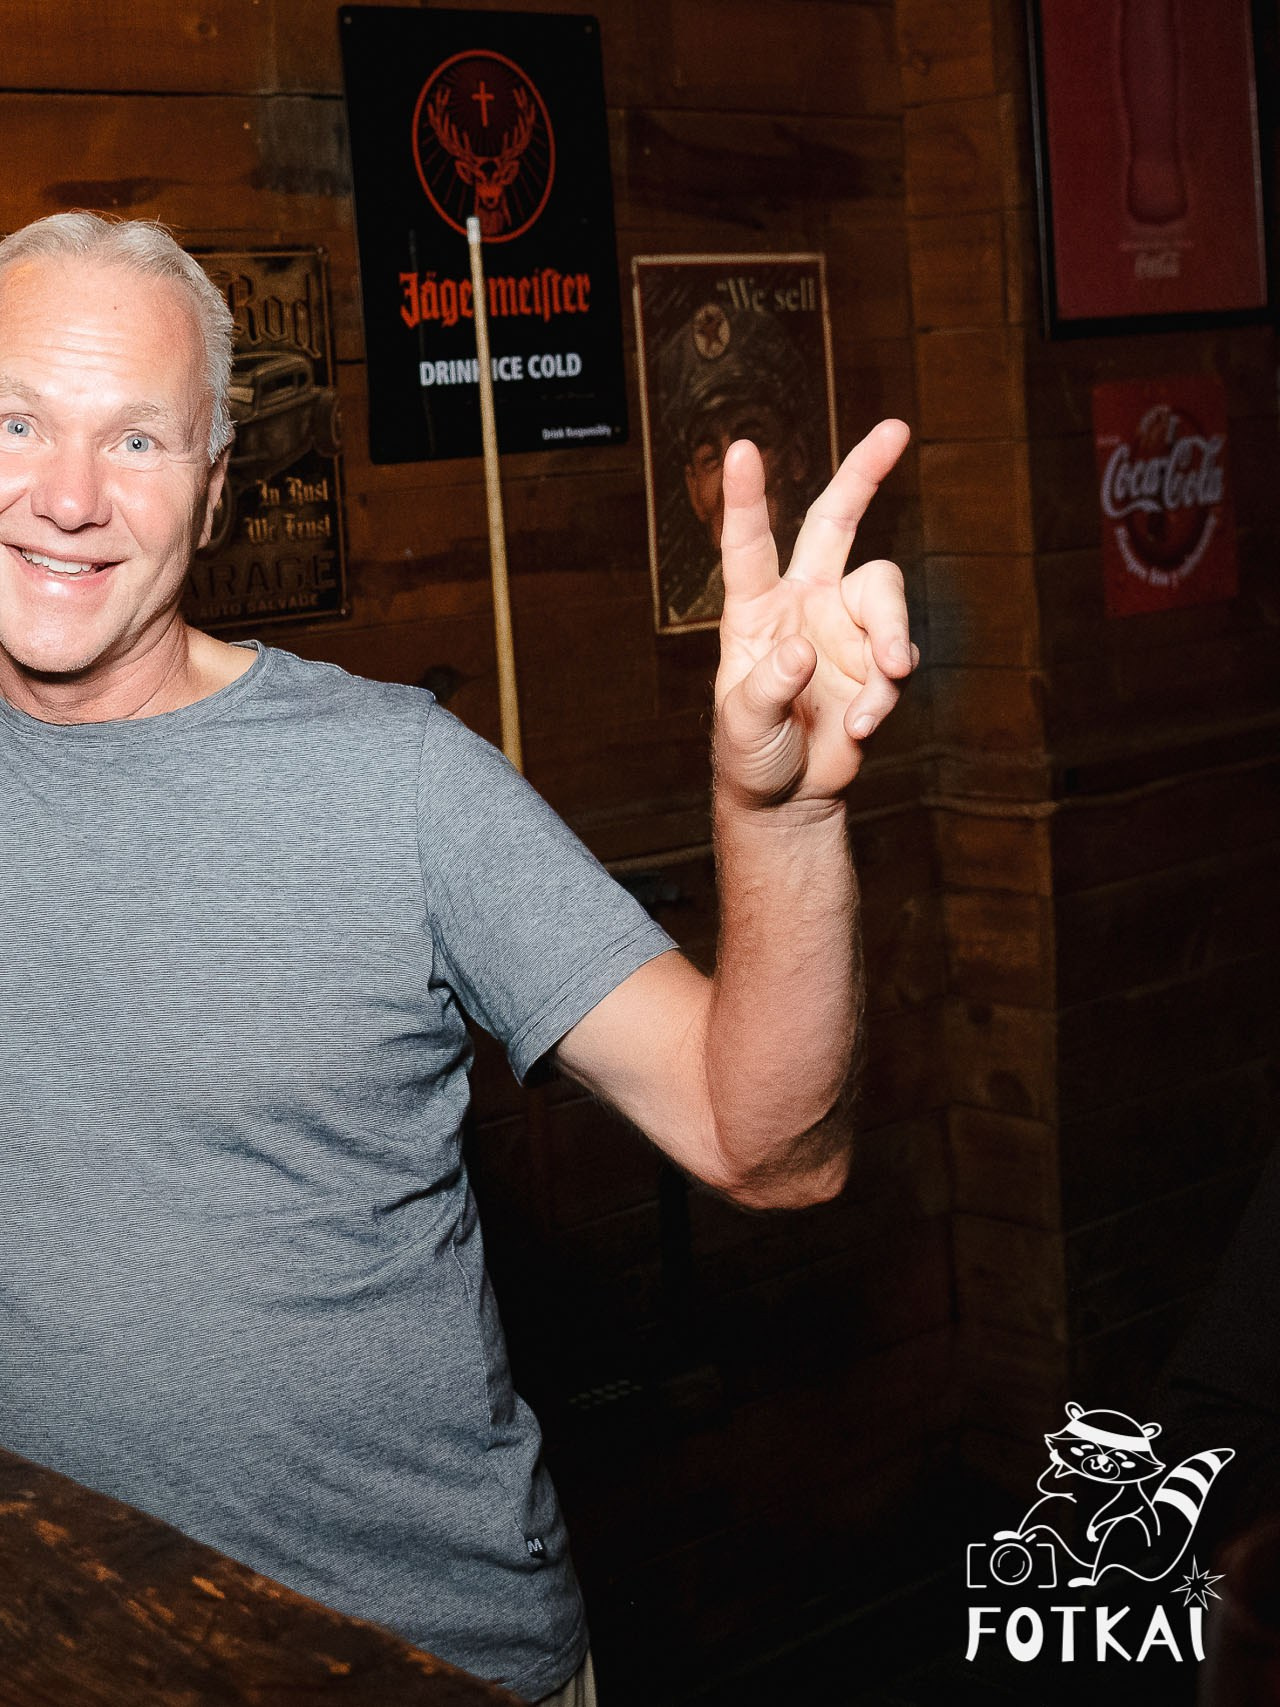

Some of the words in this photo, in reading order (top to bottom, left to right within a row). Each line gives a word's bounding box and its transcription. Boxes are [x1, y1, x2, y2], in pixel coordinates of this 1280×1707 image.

[774, 277, 817, 312] sell
[420, 358, 481, 387] DRIN
[491, 355, 524, 383] ICE
[527, 352, 583, 380] COLD
[255, 479, 281, 506] In
[284, 476, 329, 505] Rust
[283, 513, 332, 542] Trust
[526, 1538, 543, 1553] M
